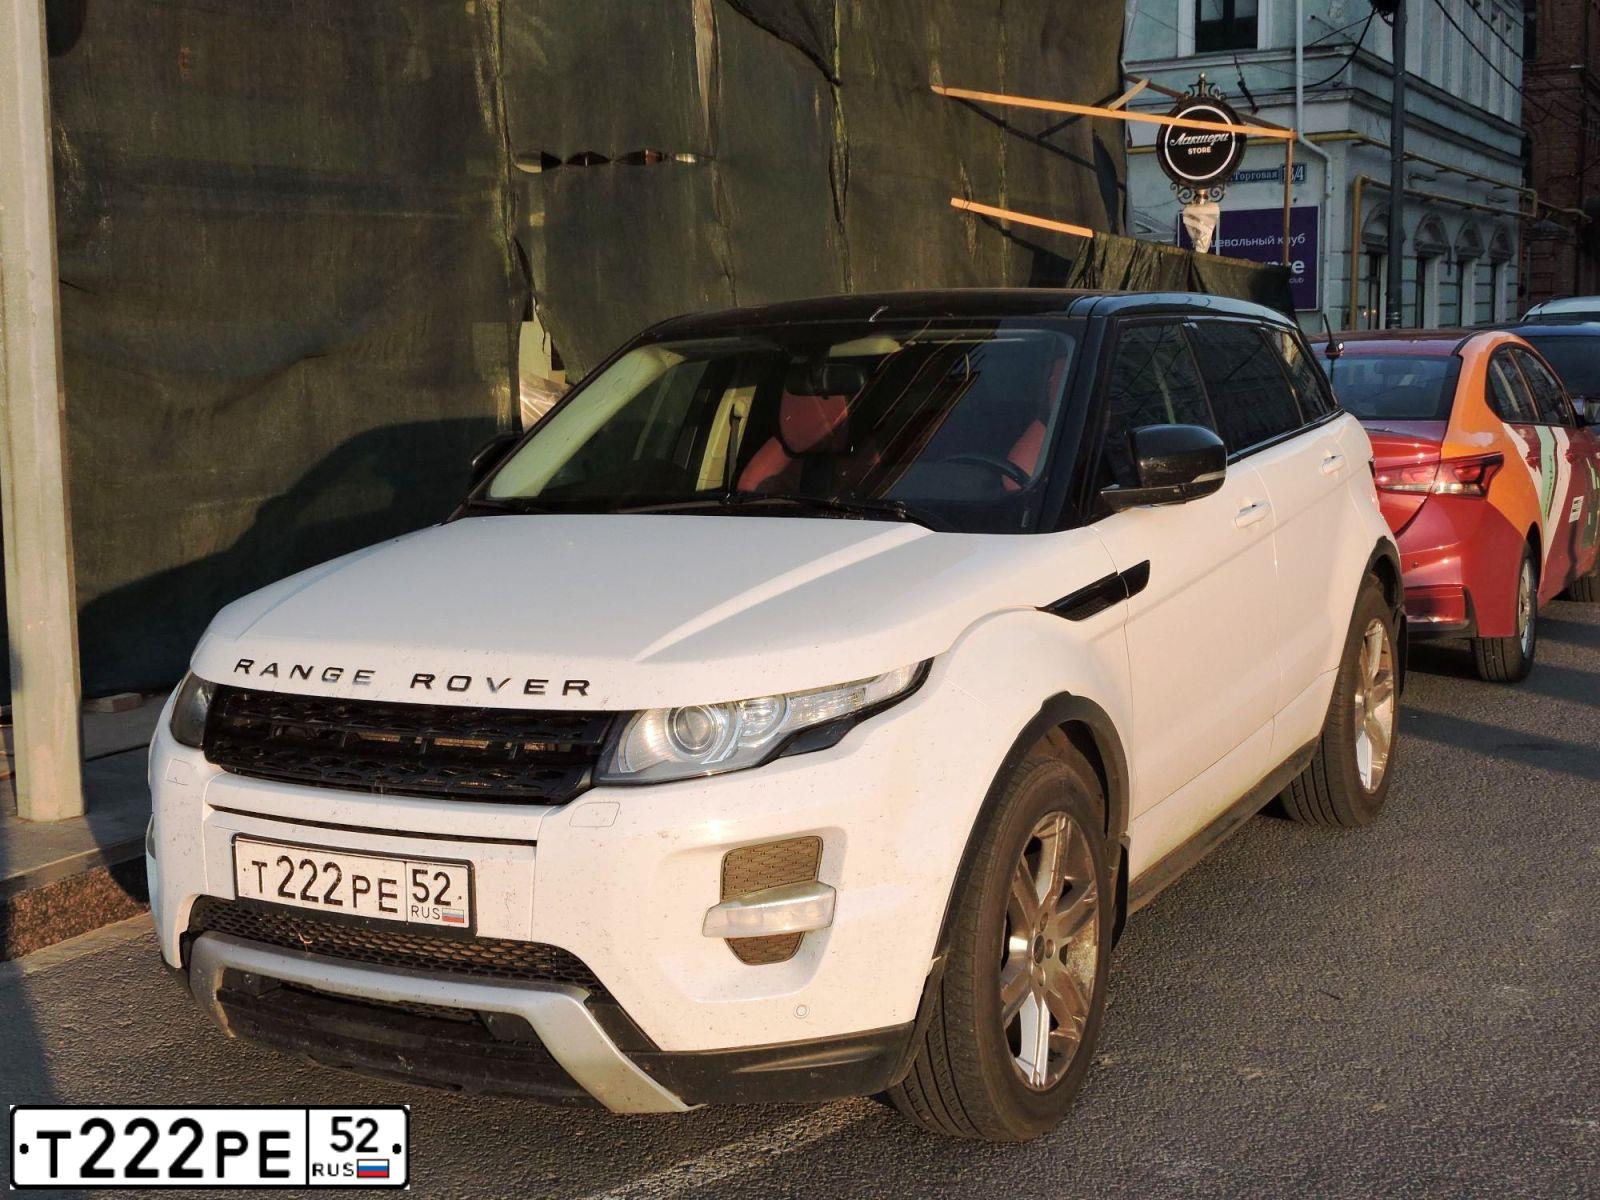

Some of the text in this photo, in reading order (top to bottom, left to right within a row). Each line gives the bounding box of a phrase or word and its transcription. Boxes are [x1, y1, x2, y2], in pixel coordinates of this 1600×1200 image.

[1170, 132, 1230, 146] Лакшери
[1187, 147, 1212, 155] STORE
[1233, 170, 1278, 181] Торговая
[1277, 233, 1306, 247] куб
[234, 658, 591, 697] RANGE ROVER
[412, 868, 452, 907] 52
[411, 904, 440, 920] RUS
